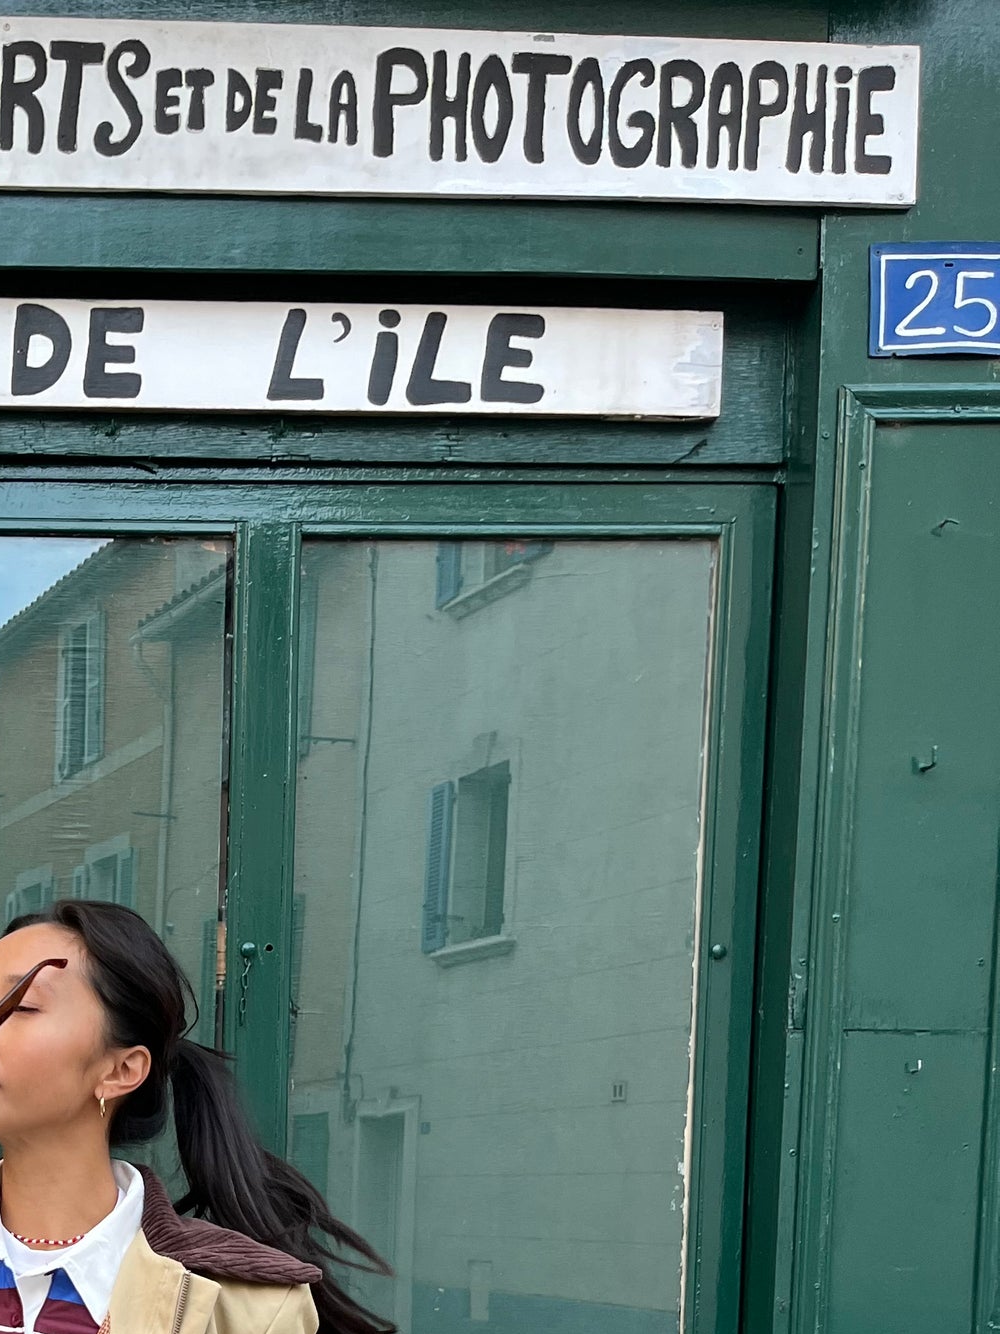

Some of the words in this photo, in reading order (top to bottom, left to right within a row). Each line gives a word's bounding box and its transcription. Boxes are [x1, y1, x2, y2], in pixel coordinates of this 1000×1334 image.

[154, 67, 215, 135] ET
[225, 67, 284, 136] DE
[294, 67, 359, 146] LA
[894, 269, 998, 338] 25
[11, 302, 145, 399] DE
